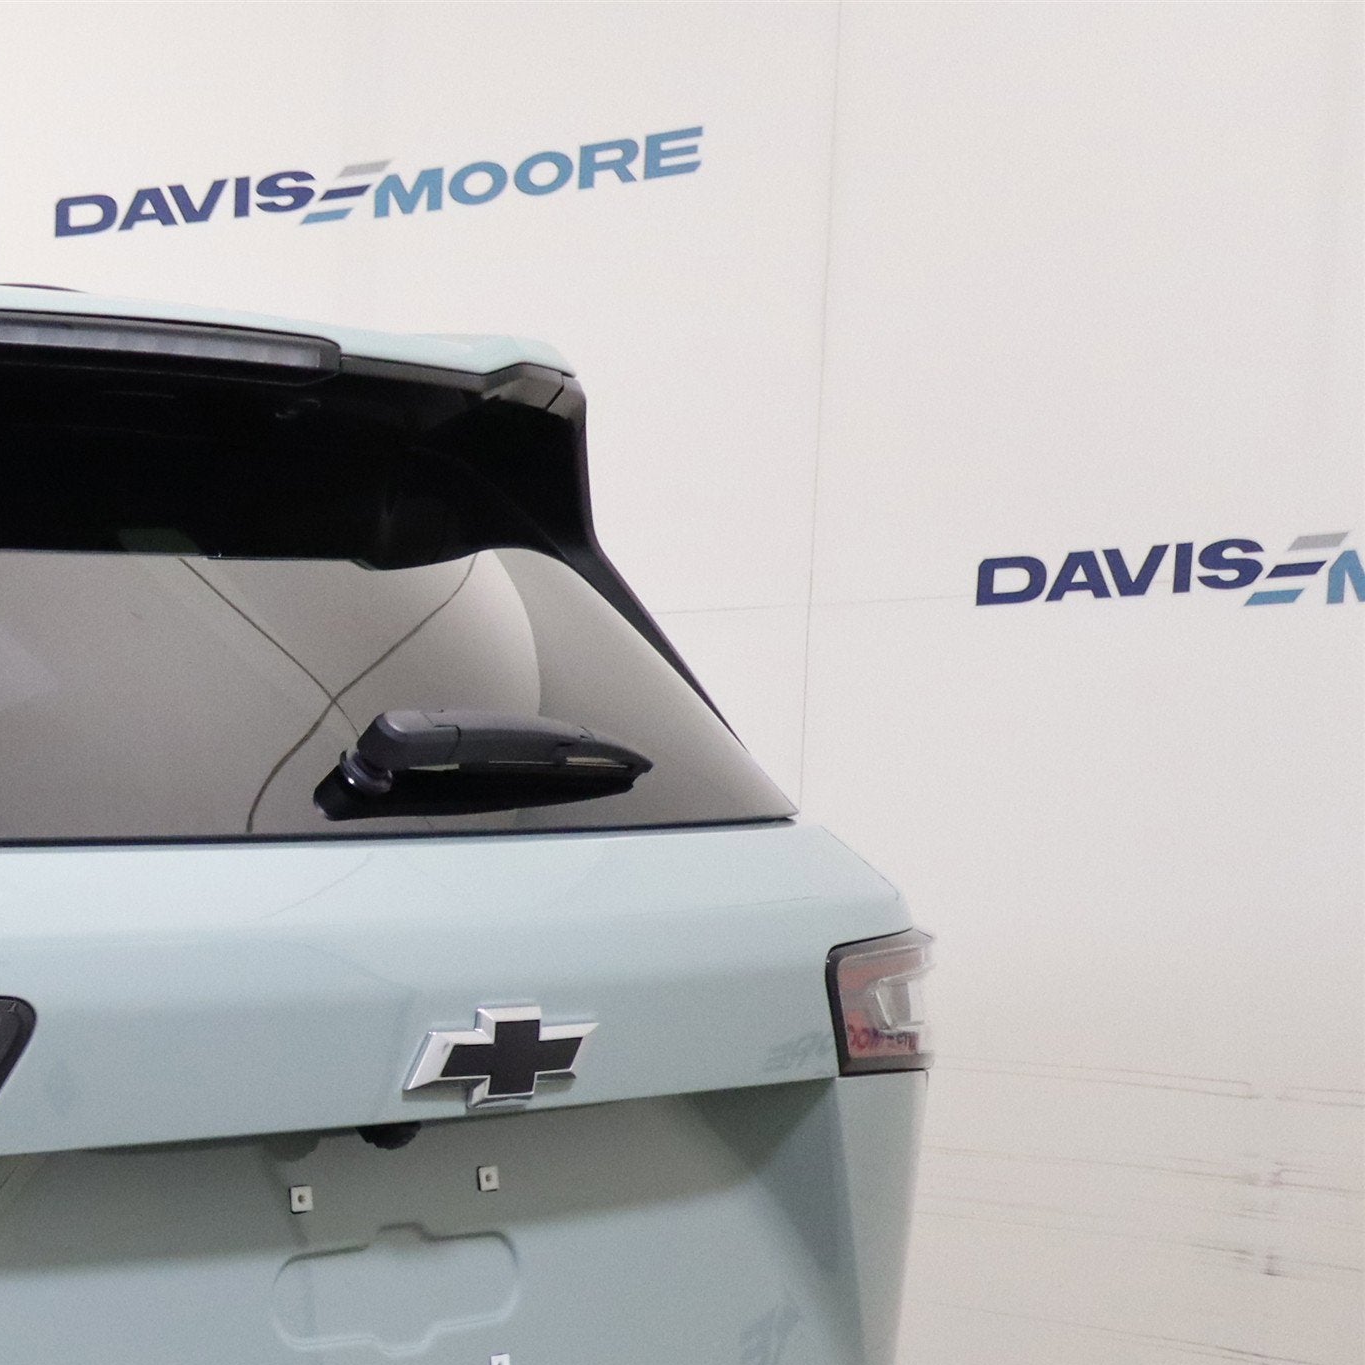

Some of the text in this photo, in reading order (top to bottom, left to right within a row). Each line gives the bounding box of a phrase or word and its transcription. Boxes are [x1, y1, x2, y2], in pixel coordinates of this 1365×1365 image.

[54, 125, 704, 238] DAVIS MOORE
[975, 538, 1265, 607] DAVIS
